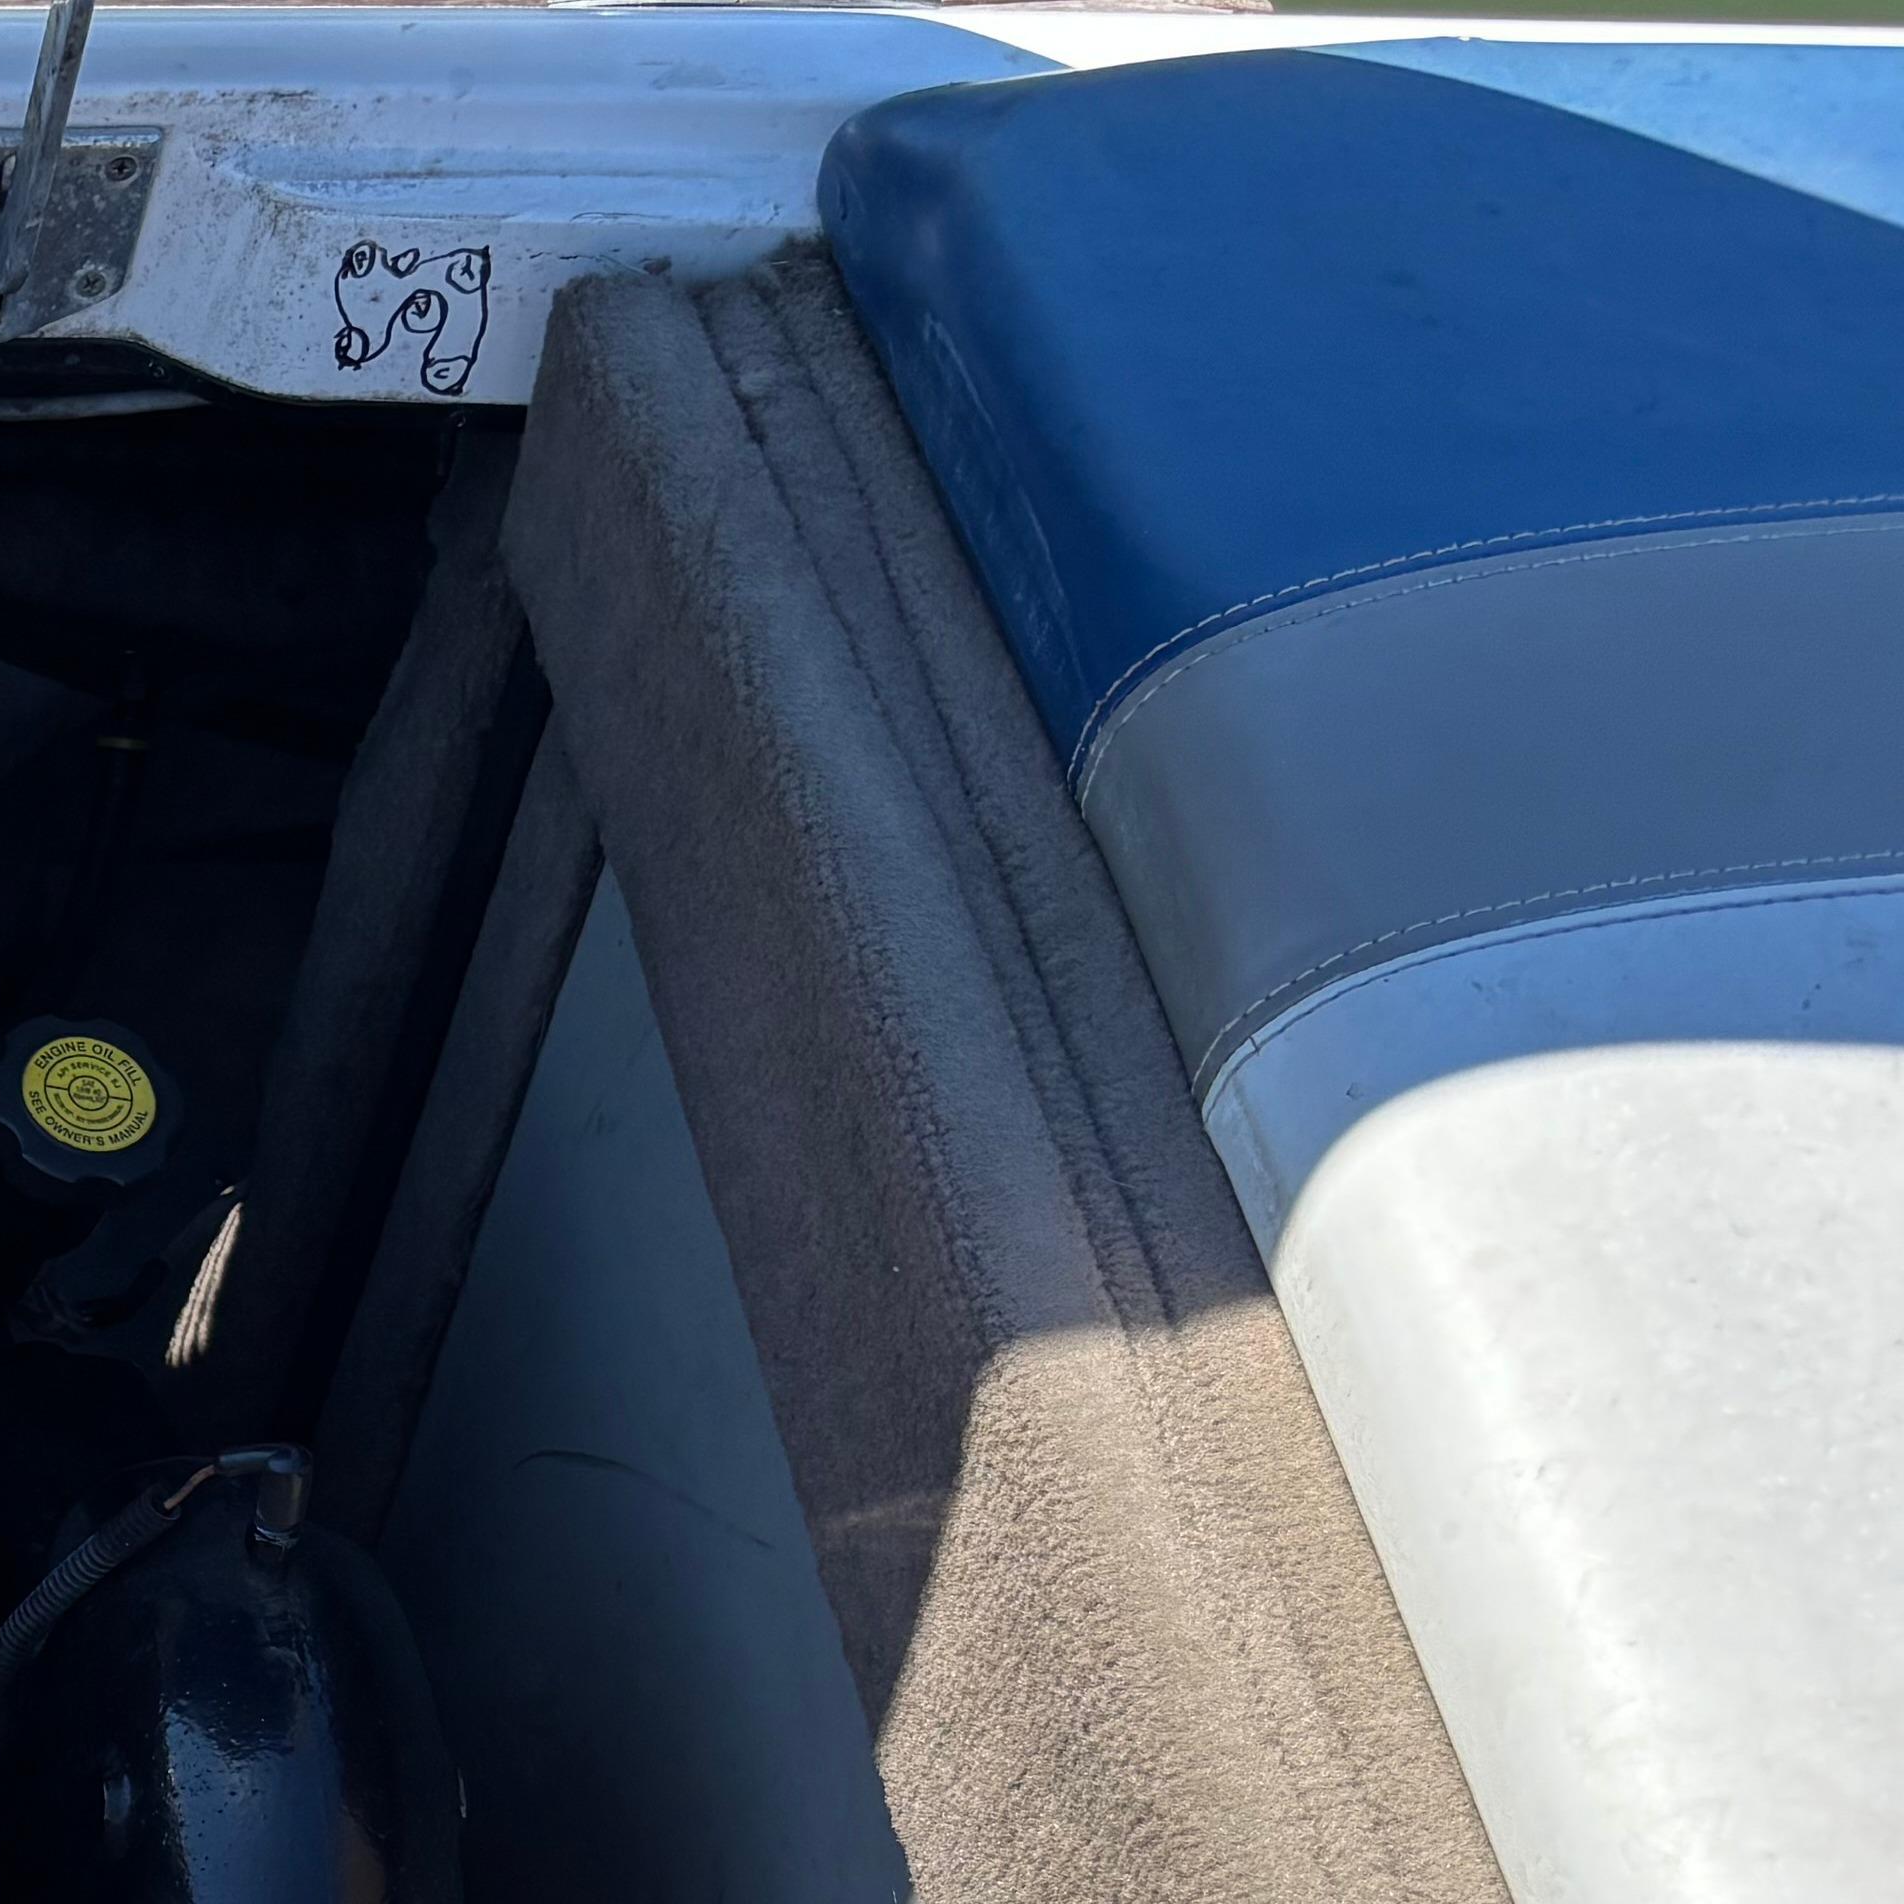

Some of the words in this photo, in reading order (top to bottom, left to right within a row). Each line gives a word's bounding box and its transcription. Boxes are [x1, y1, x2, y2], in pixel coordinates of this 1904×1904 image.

[34, 1041, 87, 1070] ENGINE
[92, 1043, 116, 1062] OIL
[117, 1058, 142, 1087] FILL
[28, 1090, 48, 1115] SEE
[44, 1116, 104, 1147] OWNER'S
[108, 1109, 149, 1145] MANUAL
